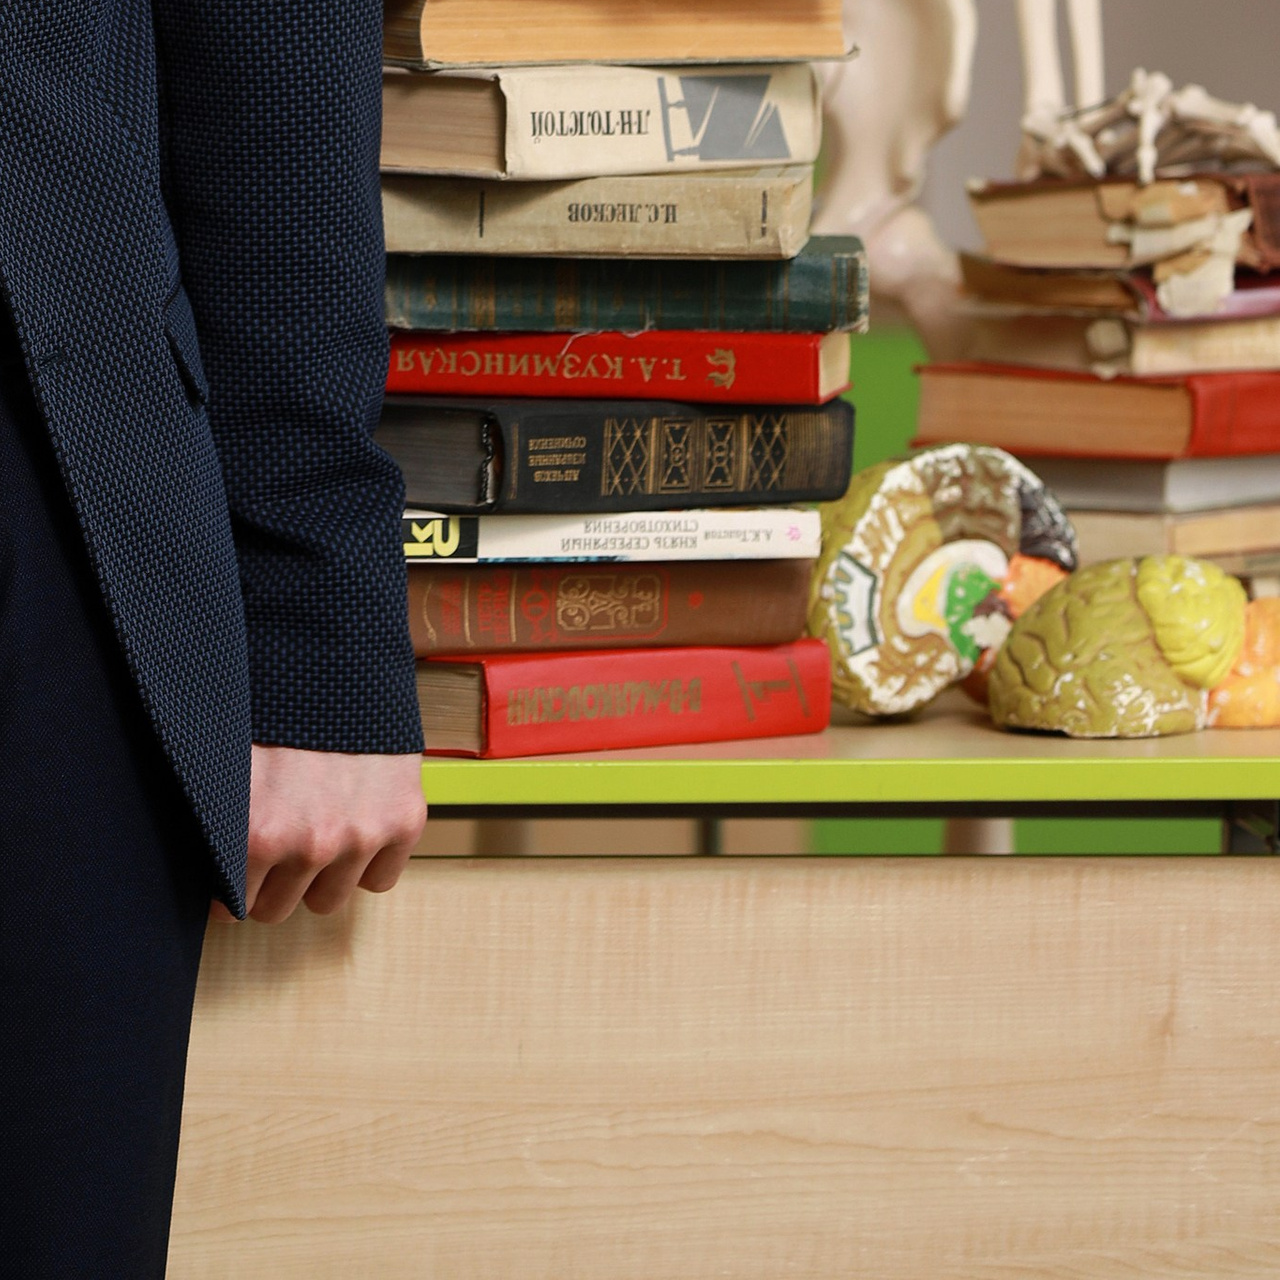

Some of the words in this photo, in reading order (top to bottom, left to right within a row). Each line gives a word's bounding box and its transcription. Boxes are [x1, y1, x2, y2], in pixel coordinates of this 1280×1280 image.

[584, 519, 699, 534] СТИХОТВОРЕНИЯ
[561, 536, 650, 552] СЕРЕБРЯНЫЙ
[654, 536, 698, 550] КНЯЗЬ
